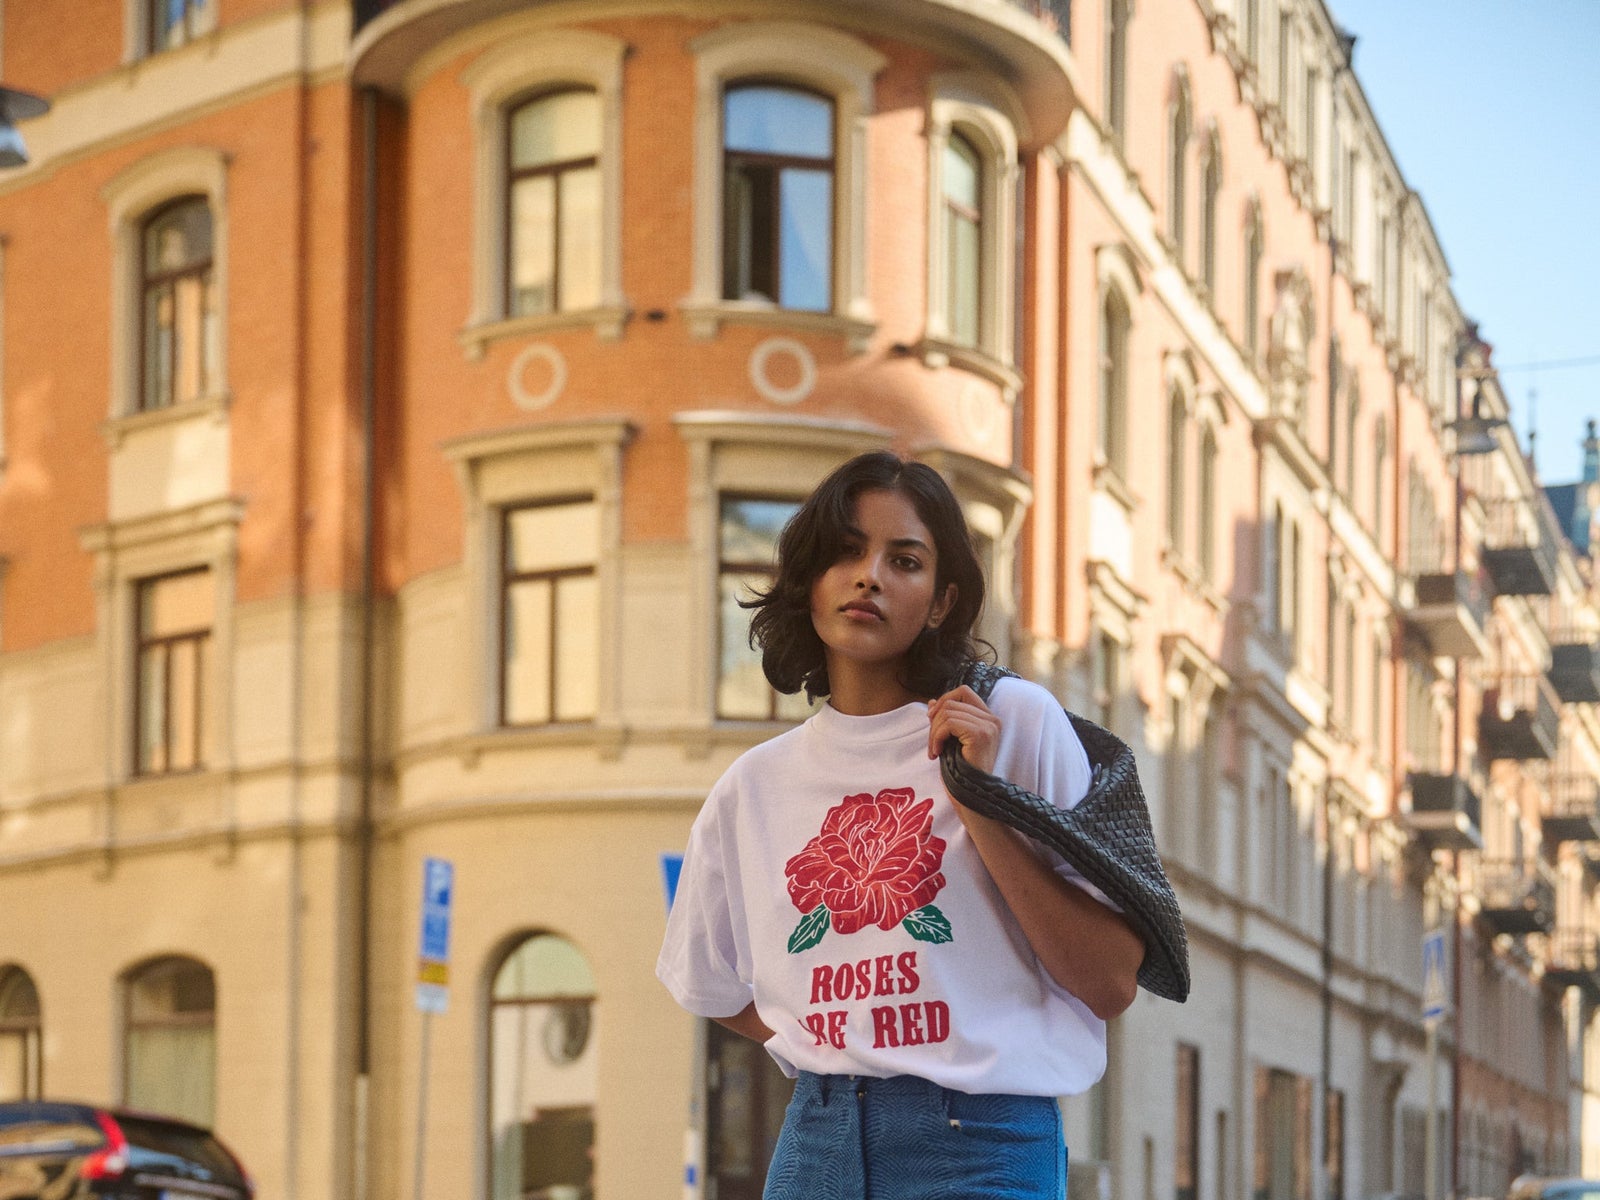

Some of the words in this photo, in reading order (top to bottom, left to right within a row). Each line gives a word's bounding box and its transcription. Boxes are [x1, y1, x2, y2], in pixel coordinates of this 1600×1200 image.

[810, 951, 920, 1004] ROSES
[797, 1010, 848, 1050] RE
[871, 1000, 950, 1049] RED
